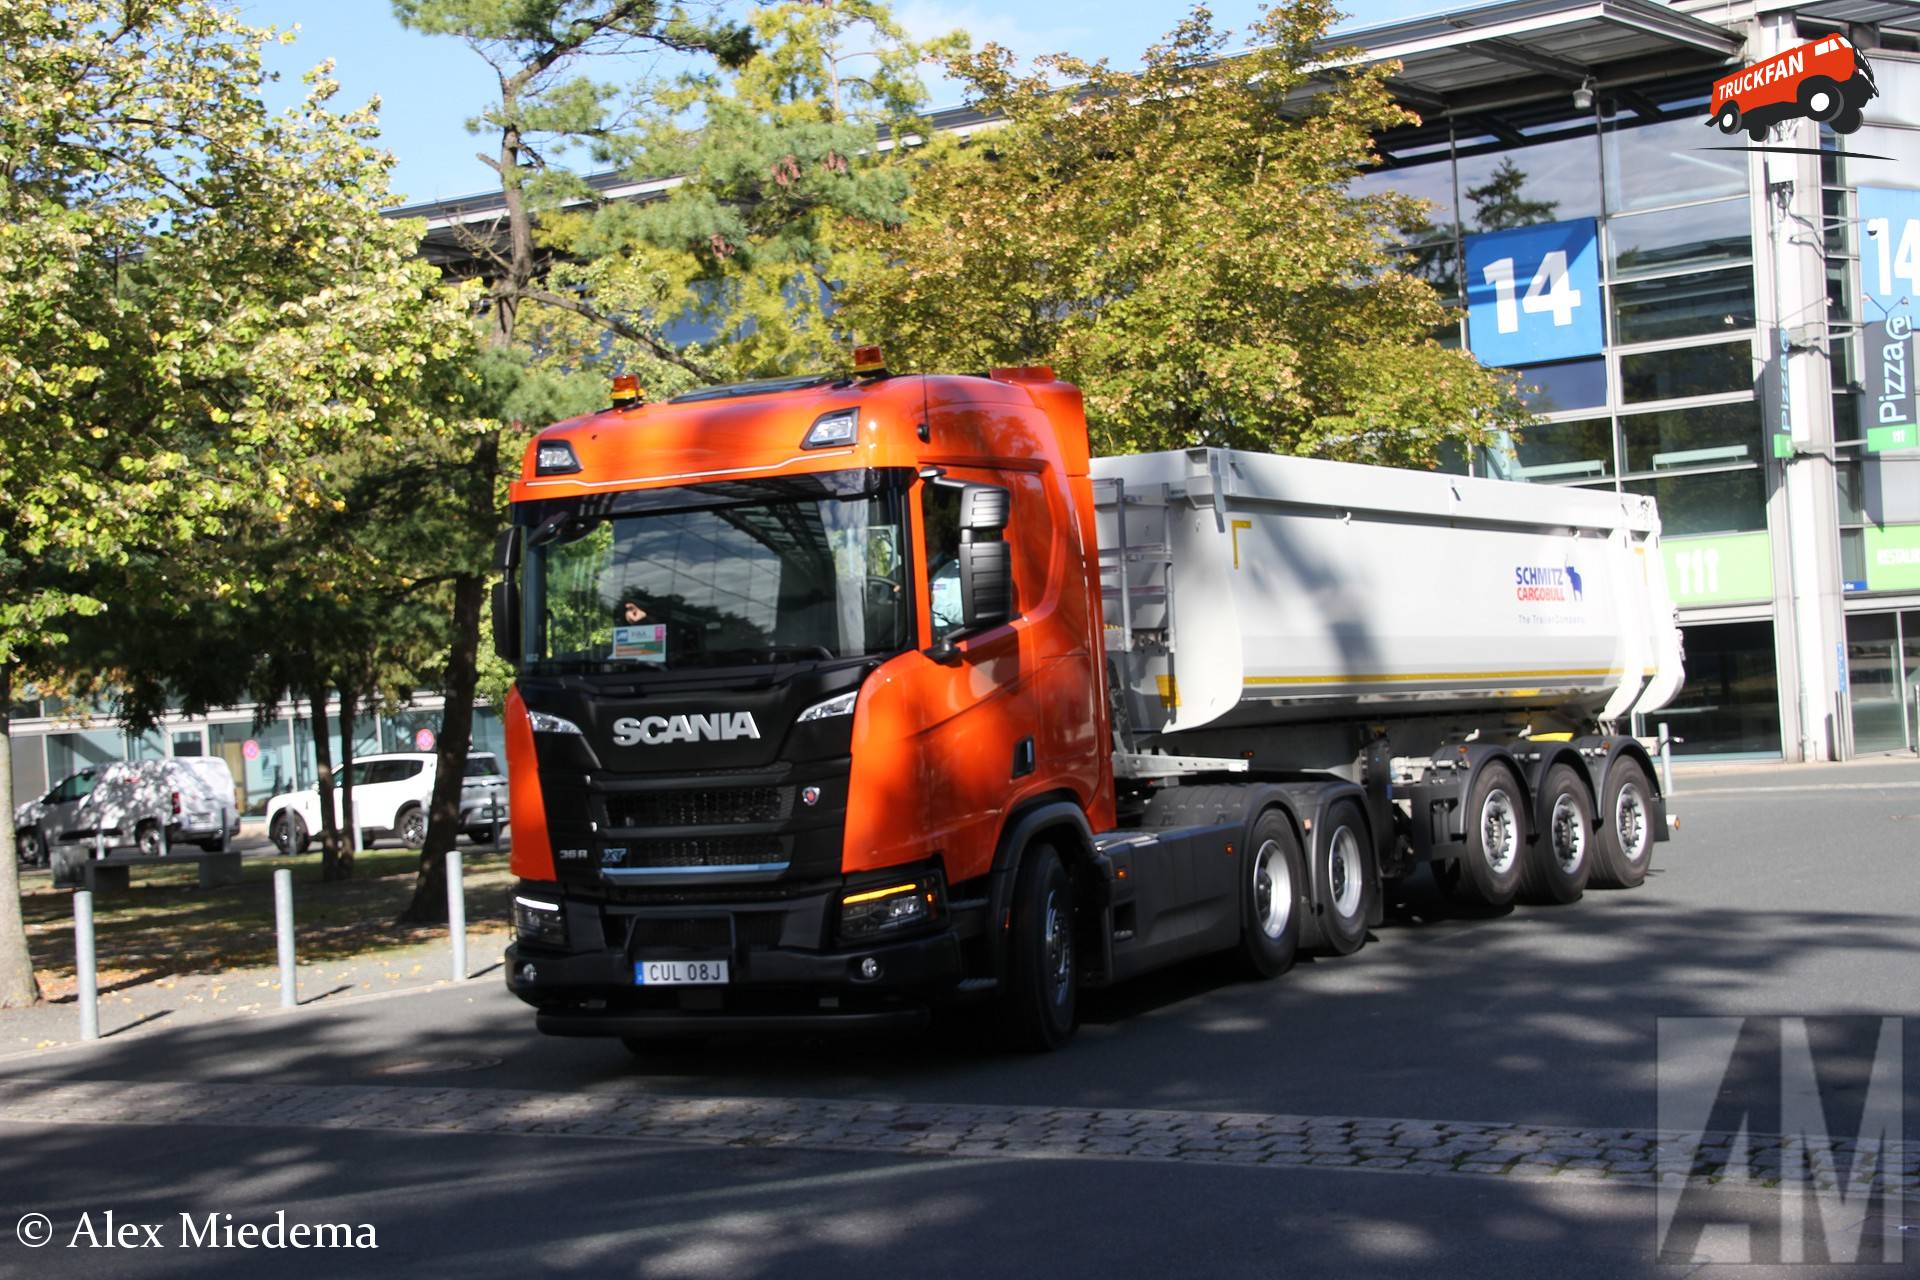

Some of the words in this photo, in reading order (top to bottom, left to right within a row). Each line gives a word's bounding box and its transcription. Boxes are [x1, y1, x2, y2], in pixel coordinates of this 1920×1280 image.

[1867, 217, 1920, 296] 14
[1482, 249, 1582, 335] 14
[1515, 566, 1564, 586] SCHMITZ
[1516, 586, 1566, 601] CARGOBULL
[613, 711, 761, 747] SCANIA
[650, 963, 682, 981] CUL
[687, 963, 721, 981] 08J
